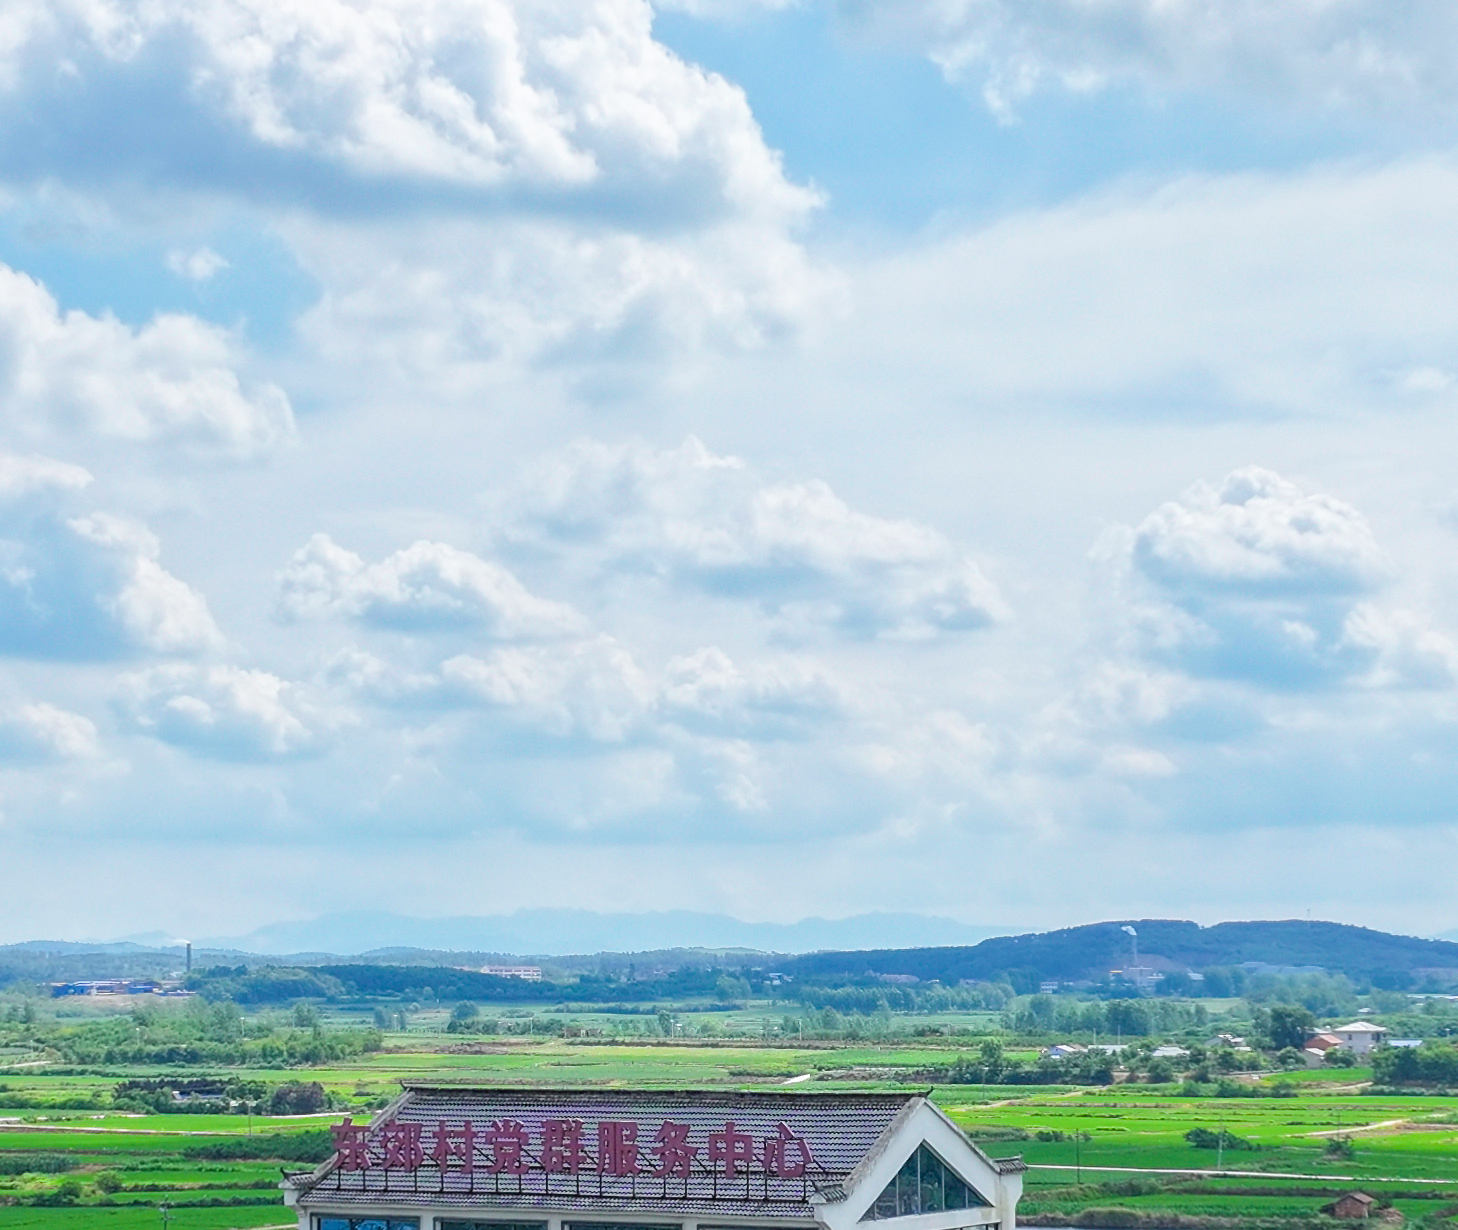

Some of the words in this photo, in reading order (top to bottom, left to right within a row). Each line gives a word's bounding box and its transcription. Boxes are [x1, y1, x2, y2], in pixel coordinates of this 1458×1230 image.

[330, 1117, 814, 1180] 东郊村党群服务中心
